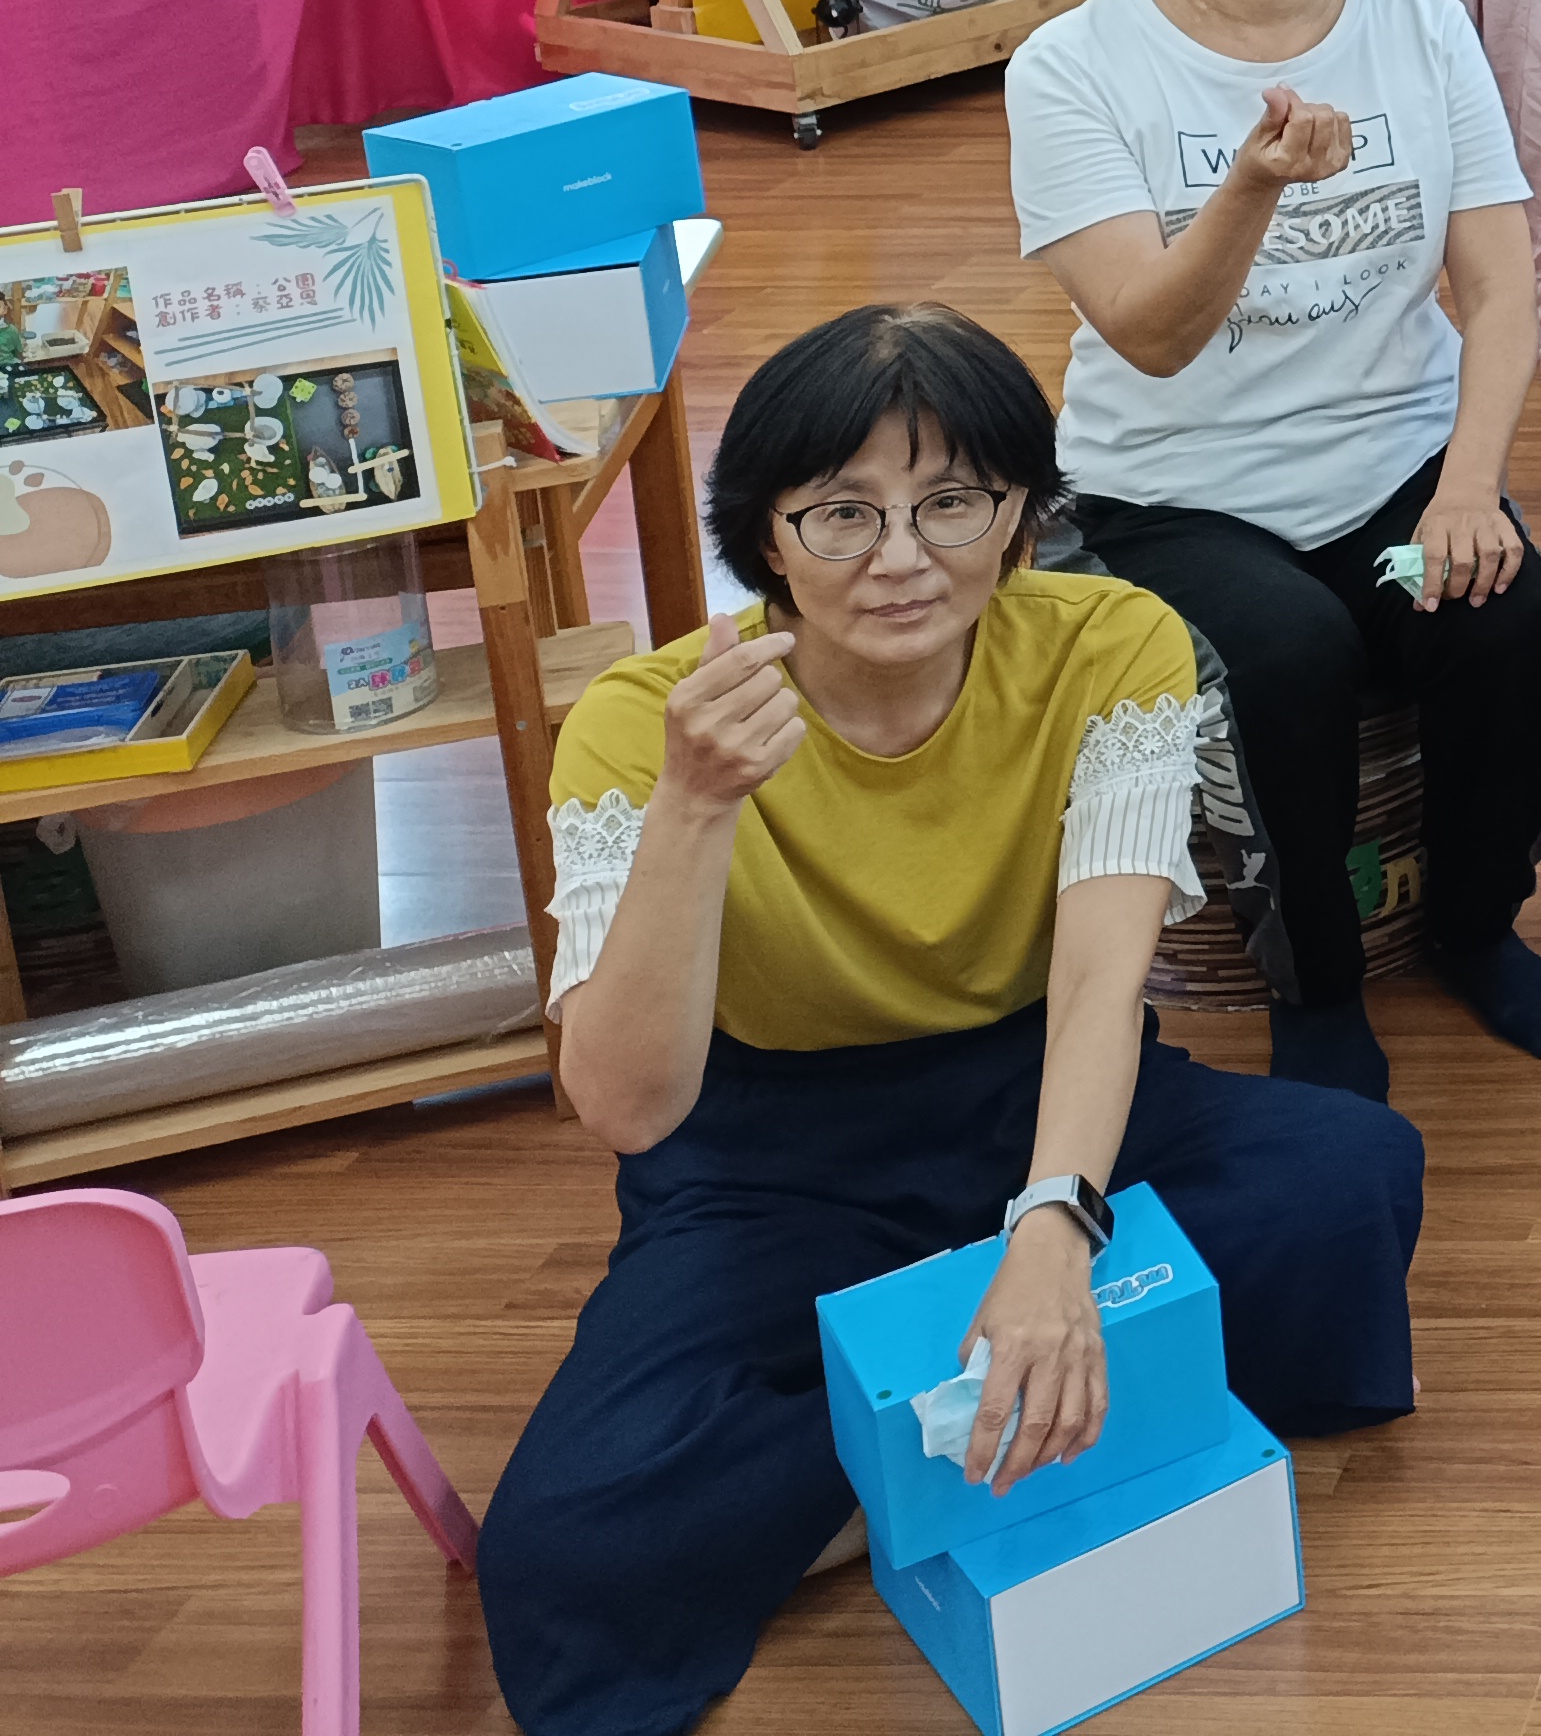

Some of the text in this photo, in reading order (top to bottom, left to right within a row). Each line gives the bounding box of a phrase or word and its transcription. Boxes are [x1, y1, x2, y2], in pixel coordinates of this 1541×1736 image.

[1301, 182, 1320, 196] BE
[1262, 197, 1412, 251] ESOME
[1238, 258, 1408, 299] DAY I LOOK
